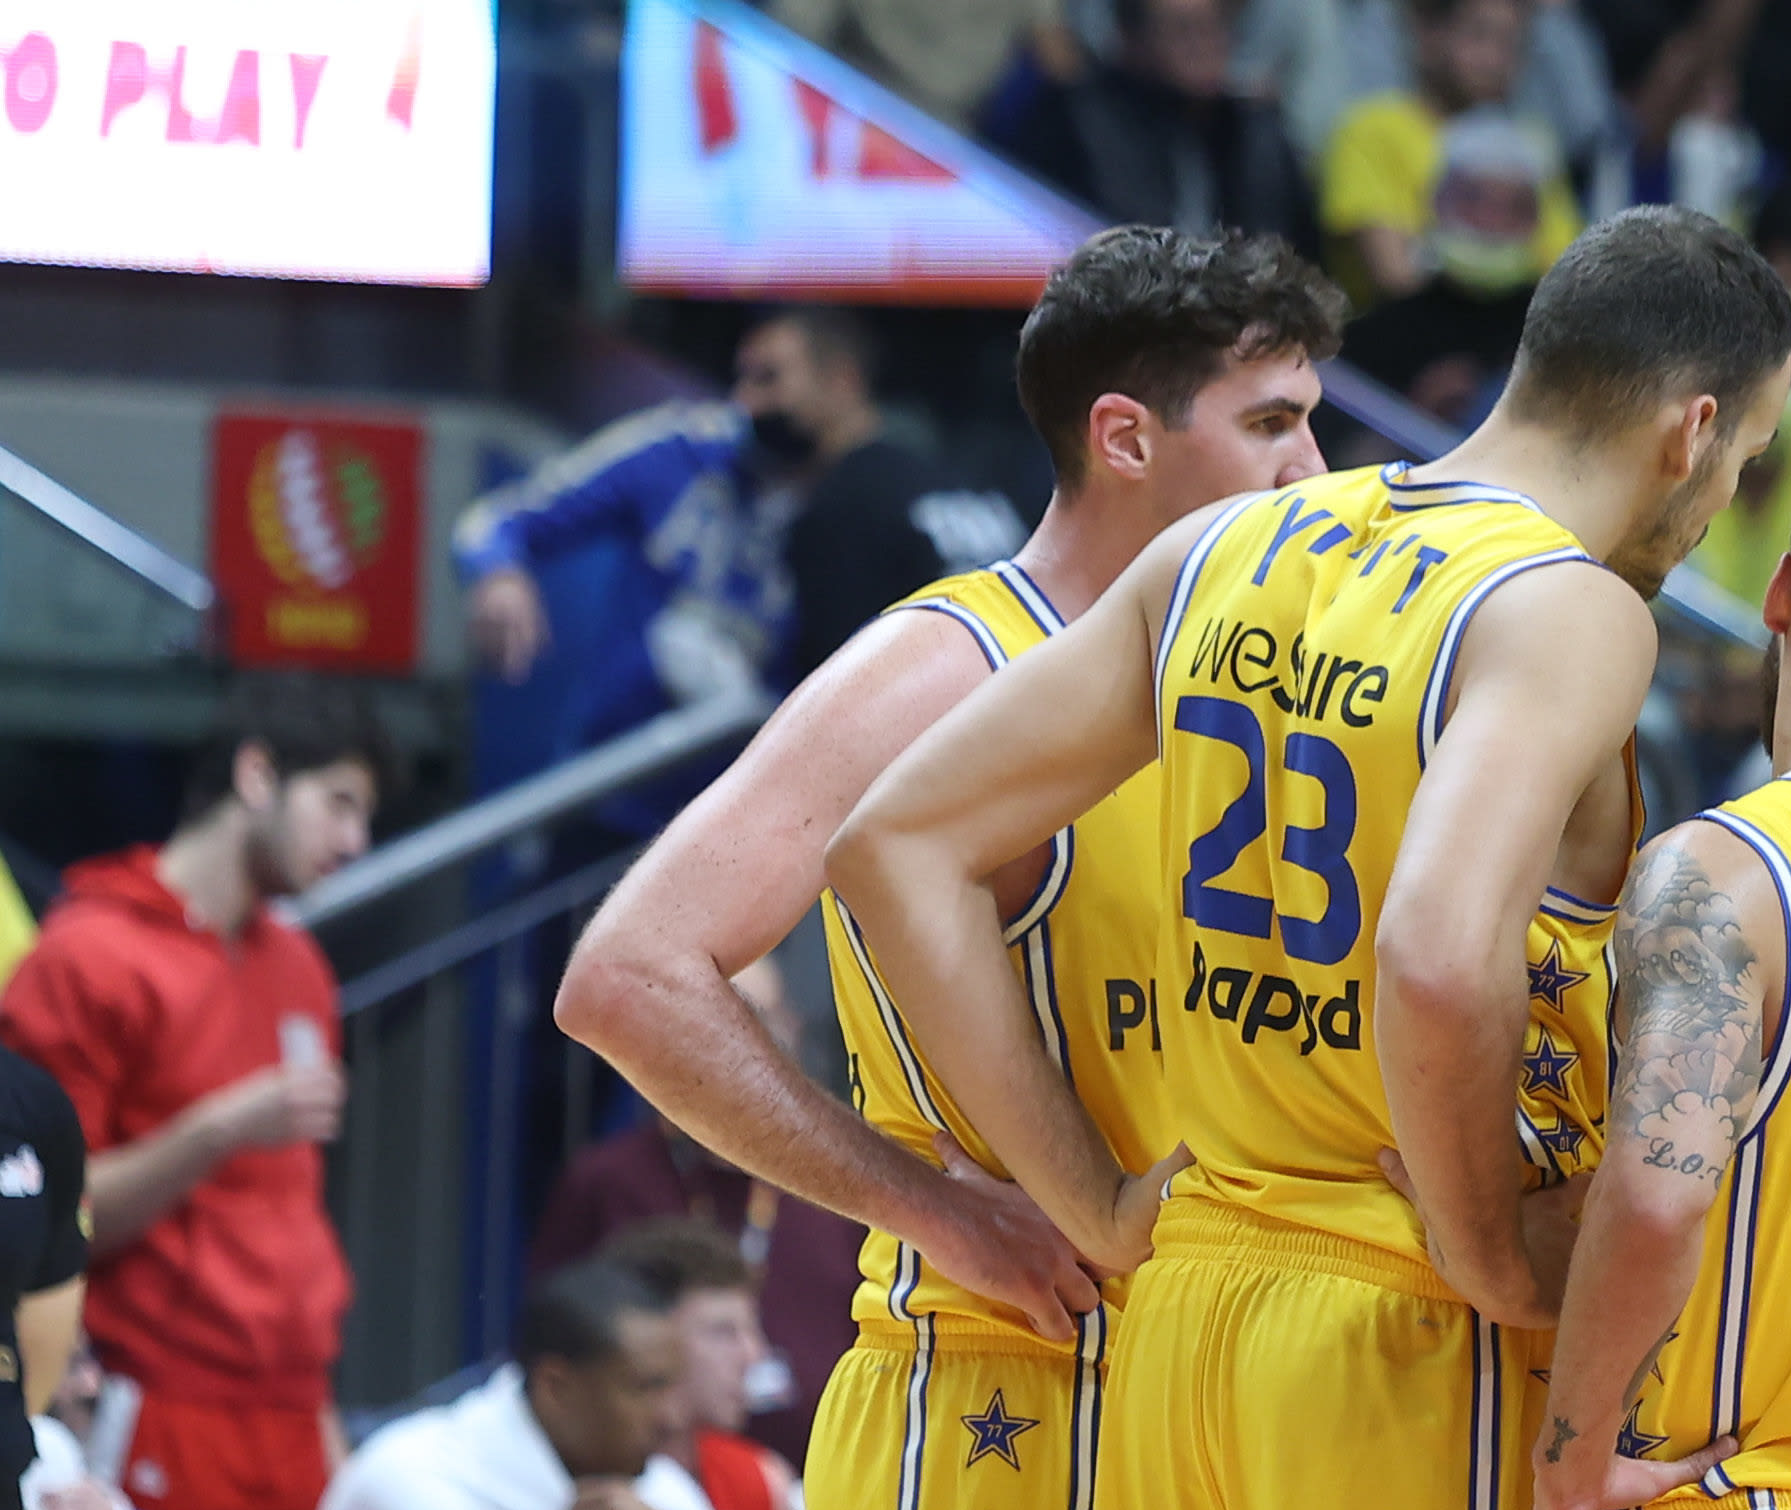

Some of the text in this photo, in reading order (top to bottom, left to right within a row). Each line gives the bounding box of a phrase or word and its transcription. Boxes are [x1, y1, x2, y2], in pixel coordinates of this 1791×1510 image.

[0, 30, 330, 150] O PLAY
[1174, 695, 1362, 966] 23
[986, 1423, 1002, 1439] 77
